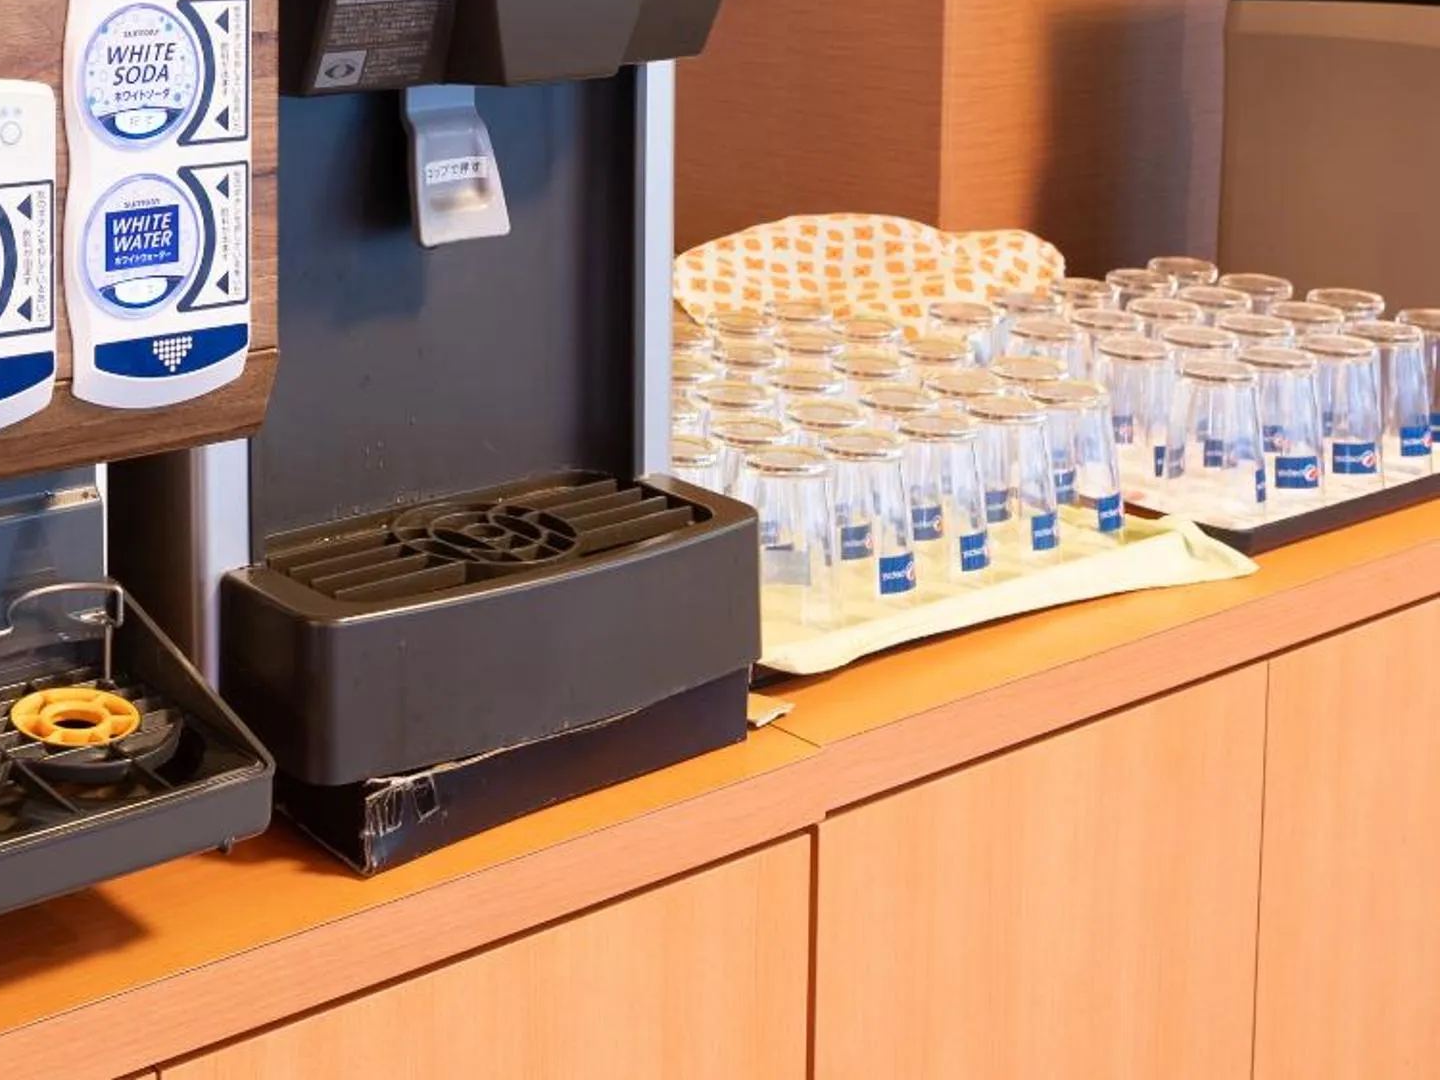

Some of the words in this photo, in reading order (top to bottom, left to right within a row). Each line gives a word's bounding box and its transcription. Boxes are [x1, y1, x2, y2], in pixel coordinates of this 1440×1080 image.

[107, 42, 176, 65] WHITE
[112, 63, 169, 86] SODA
[114, 87, 170, 102] ホワイトソーダ
[112, 211, 173, 236] WHITE
[113, 229, 173, 253] WATER
